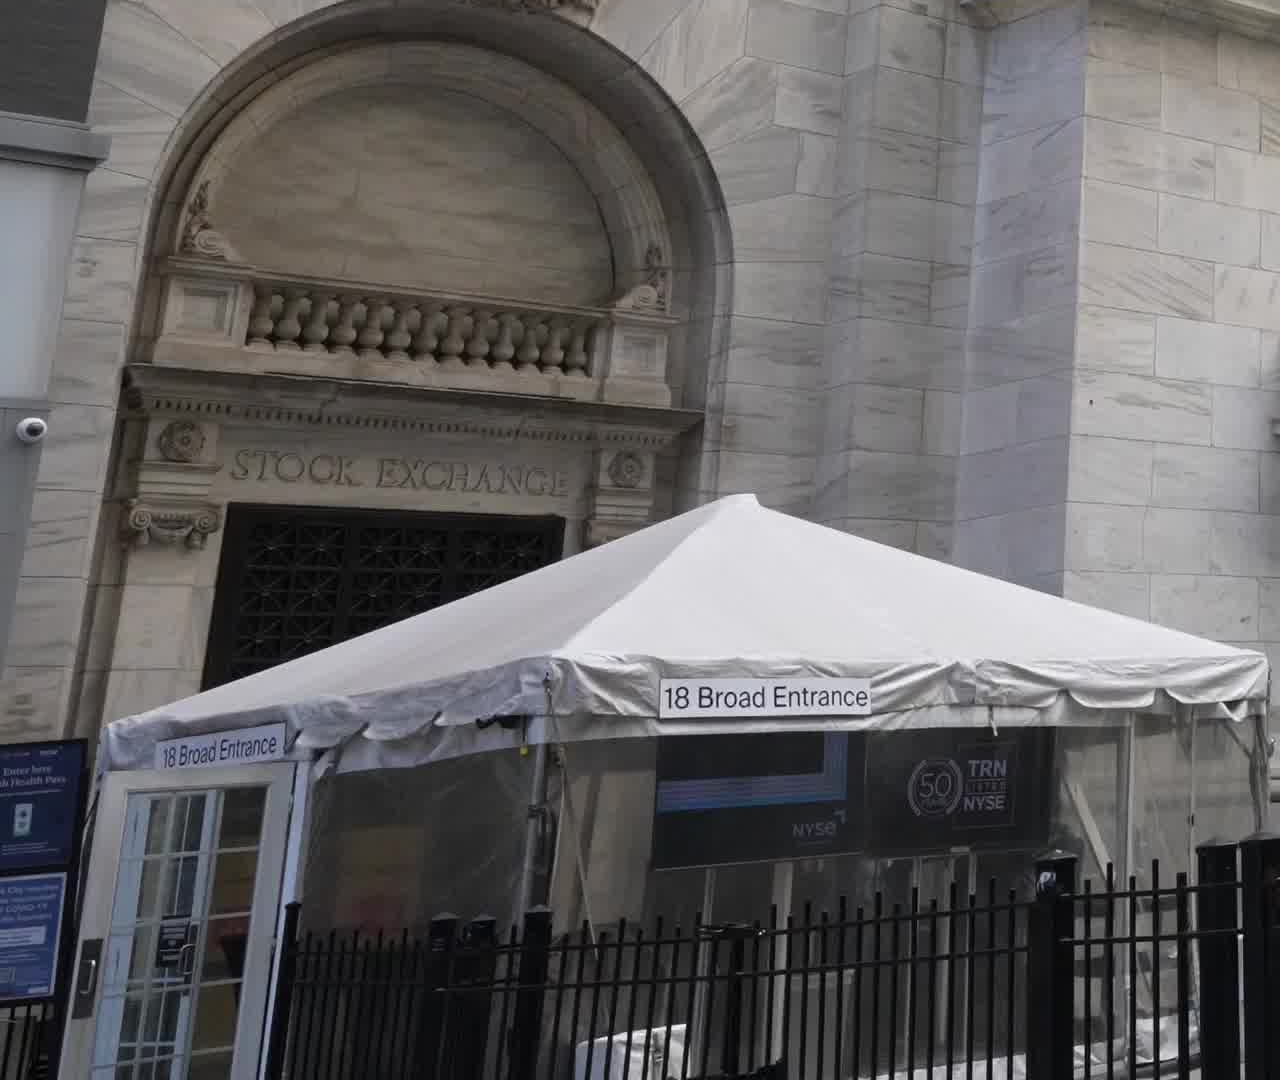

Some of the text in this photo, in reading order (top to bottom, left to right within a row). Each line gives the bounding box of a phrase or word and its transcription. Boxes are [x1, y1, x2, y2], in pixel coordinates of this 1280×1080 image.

[229, 448, 571, 498] STOCK EXCHANGE
[664, 685, 869, 710] 18 Broad Entrance
[162, 736, 278, 769] 18 Broad Entrance
[968, 759, 1008, 777] TRN
[963, 795, 1005, 812] NYSE
